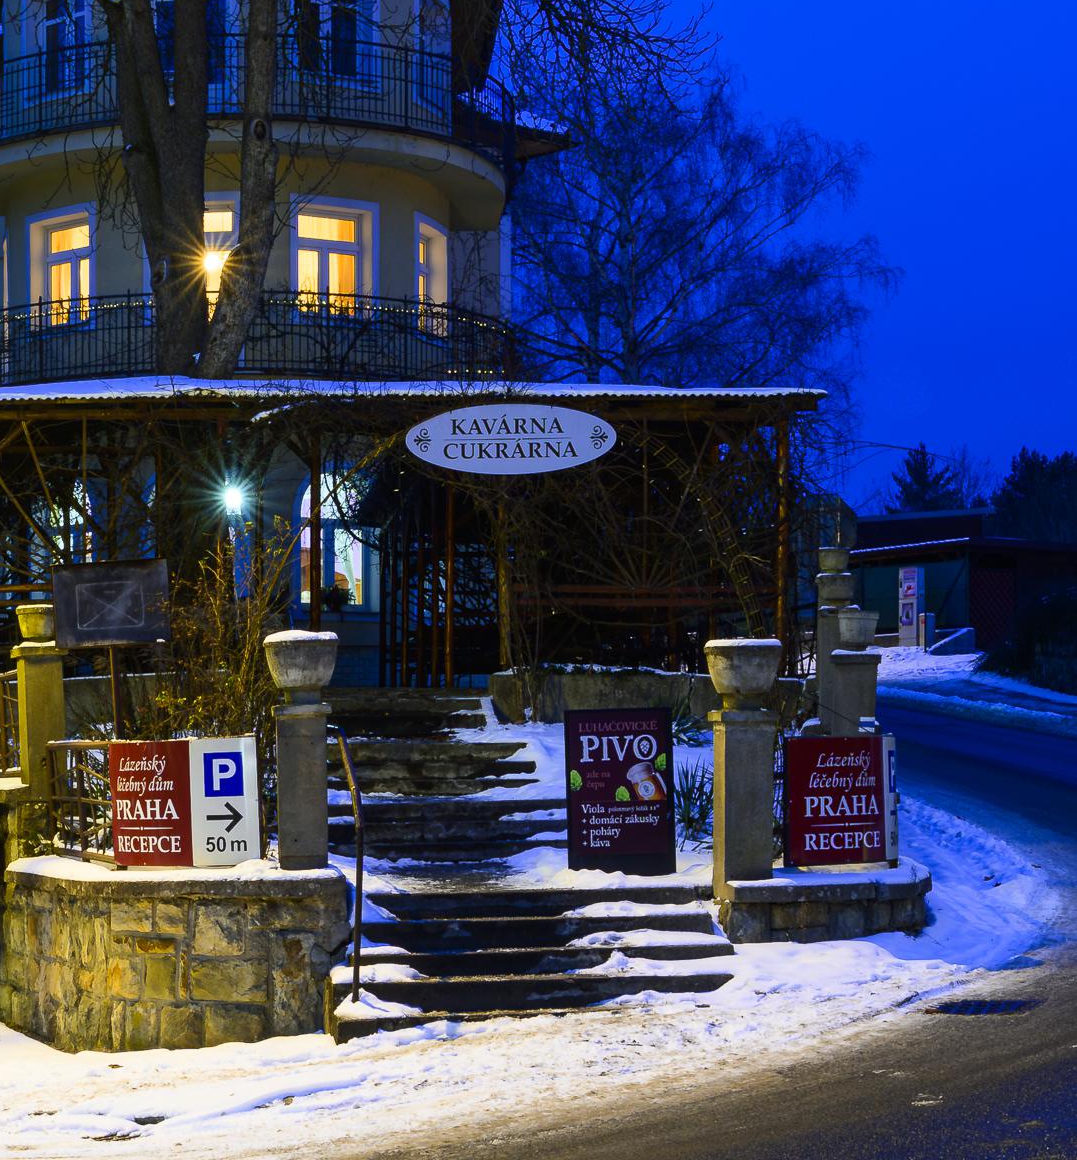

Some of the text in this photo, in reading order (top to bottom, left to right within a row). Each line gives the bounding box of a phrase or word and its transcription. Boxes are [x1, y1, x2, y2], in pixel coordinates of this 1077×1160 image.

[450, 414, 564, 435] KAVÁRNA
[443, 439, 578, 459] CUKRÁRNA
[578, 720, 658, 733] LUHAČOVICKÉ
[579, 734, 658, 763] PIVO
[118, 755, 166, 776] Lázeňský
[816, 751, 871, 770] Lázeňský
[212, 759, 236, 791] P
[808, 770, 876, 792] léčebný dům
[116, 775, 174, 796] léčebný dům
[116, 799, 179, 820] PRAHA
[581, 803, 605, 814] Viola
[803, 794, 880, 818] PRAHA
[589, 814, 623, 825] domácí
[624, 813, 660, 826] zákusky
[590, 826, 621, 839] poháry
[590, 836, 611, 848] káva
[804, 831, 881, 851] RECEPCE
[118, 836, 181, 854] RECEPCE
[206, 837, 248, 853] 50 m
